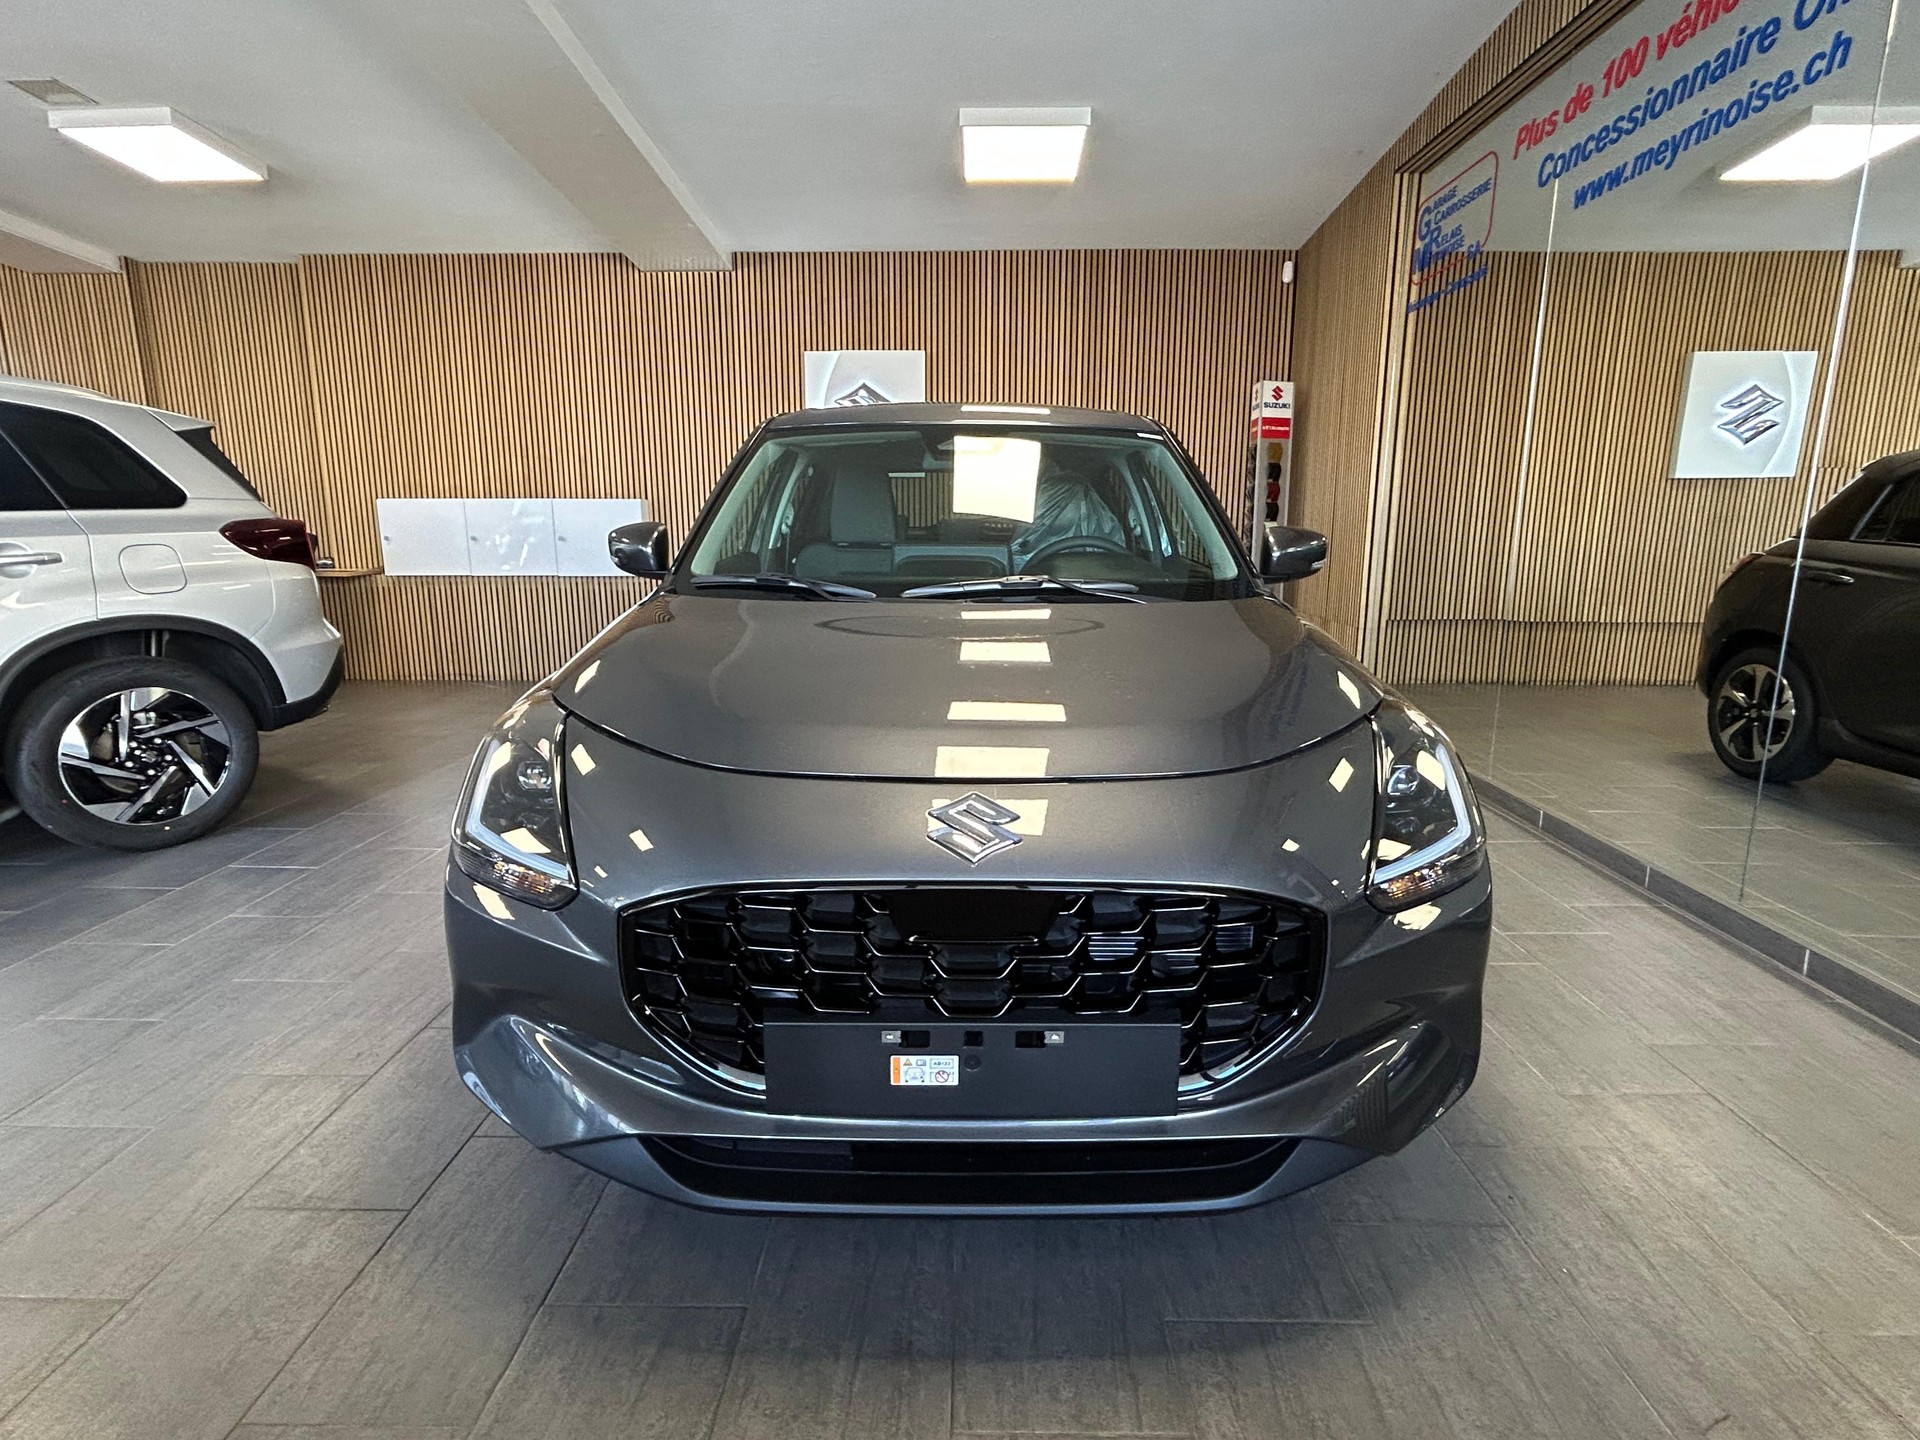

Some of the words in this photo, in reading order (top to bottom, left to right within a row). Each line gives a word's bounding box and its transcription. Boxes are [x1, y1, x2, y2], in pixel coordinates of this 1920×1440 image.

[1513, 109, 1560, 161] Plus
[1562, 82, 1595, 124] de
[1602, 36, 1650, 99] 100
[1655, 0, 1740, 61] véh
[1537, 16, 1781, 188] Concessionnaire
[1572, 30, 1853, 210] www.meyrinoise.ch
